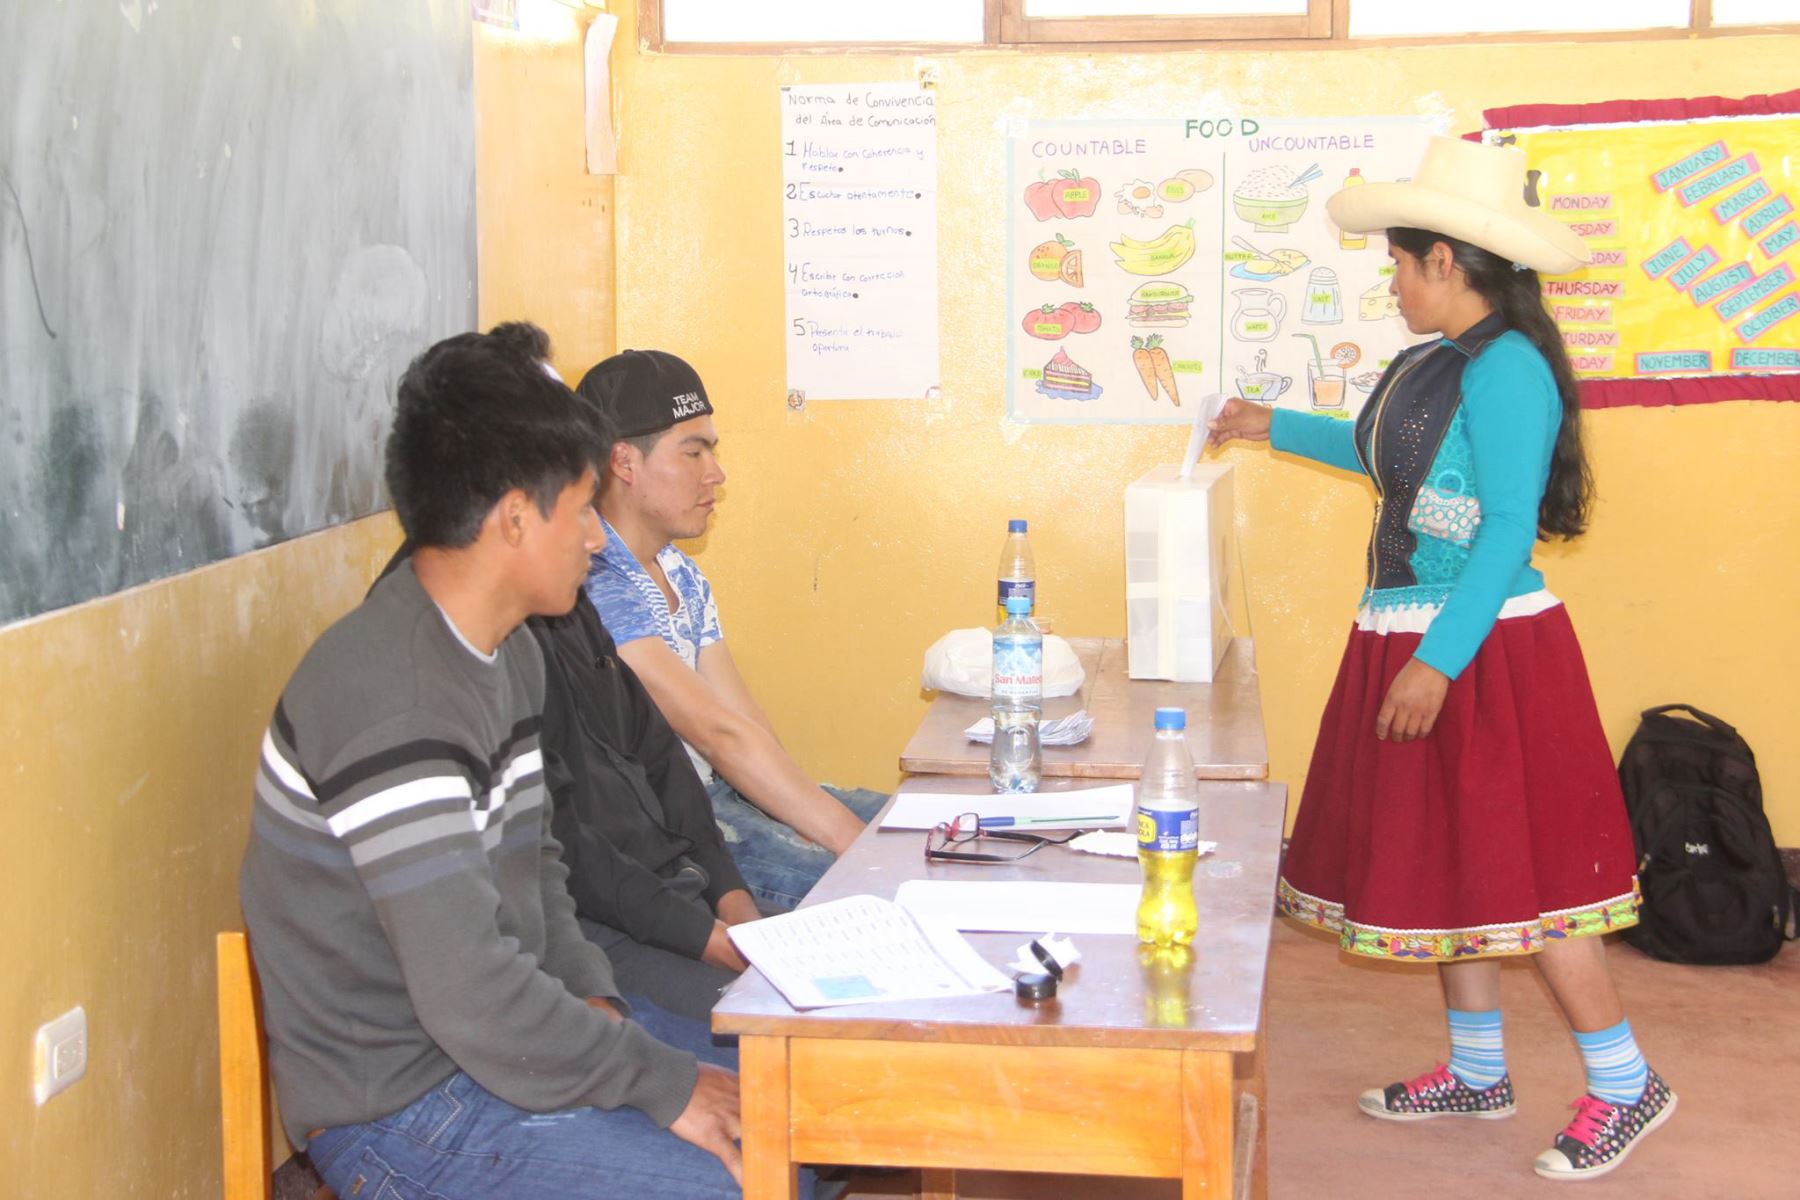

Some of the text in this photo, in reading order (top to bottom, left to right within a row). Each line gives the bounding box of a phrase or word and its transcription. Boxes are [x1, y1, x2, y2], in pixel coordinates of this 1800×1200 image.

[789, 92, 934, 108] Norma de Convivencia
[796, 114, 812, 125] del
[850, 115, 863, 126] de
[1185, 119, 1259, 138] FOOD
[785, 140, 797, 156] 1
[1032, 139, 1146, 158] COUNTABLE
[1249, 134, 1375, 152] UNCOUNTABLE
[1659, 144, 1722, 189] JANUARY
[786, 183, 797, 199] 2
[1683, 162, 1748, 204] FEBRUARY
[1064, 190, 1089, 200] APPLE
[1552, 196, 1609, 210] MONDAY
[1720, 184, 1766, 218] MARCH
[1749, 202, 1785, 233] APRIL
[788, 218, 799, 238] 3
[1569, 223, 1611, 236] ESDAY
[1765, 228, 1795, 254] MAY
[1647, 244, 1684, 274] JUNE
[788, 263, 798, 284] 4
[1675, 254, 1706, 286] JULY
[1547, 281, 1618, 295] THURSDAY
[1695, 264, 1747, 302] AUGUST
[1719, 268, 1787, 318] SEPTEMBER
[1556, 306, 1606, 320] FRIDAY
[1742, 297, 1798, 337] OCTOBER
[793, 318, 807, 336] 5
[1562, 332, 1616, 345] TURDAY
[1568, 356, 1608, 369] NDAY
[1640, 354, 1708, 370] NOVEMBER
[672, 391, 699, 406] TEAM
[1246, 386, 1261, 395] TEA
[672, 400, 706, 419] MAJOR
[995, 672, 1013, 684] San
